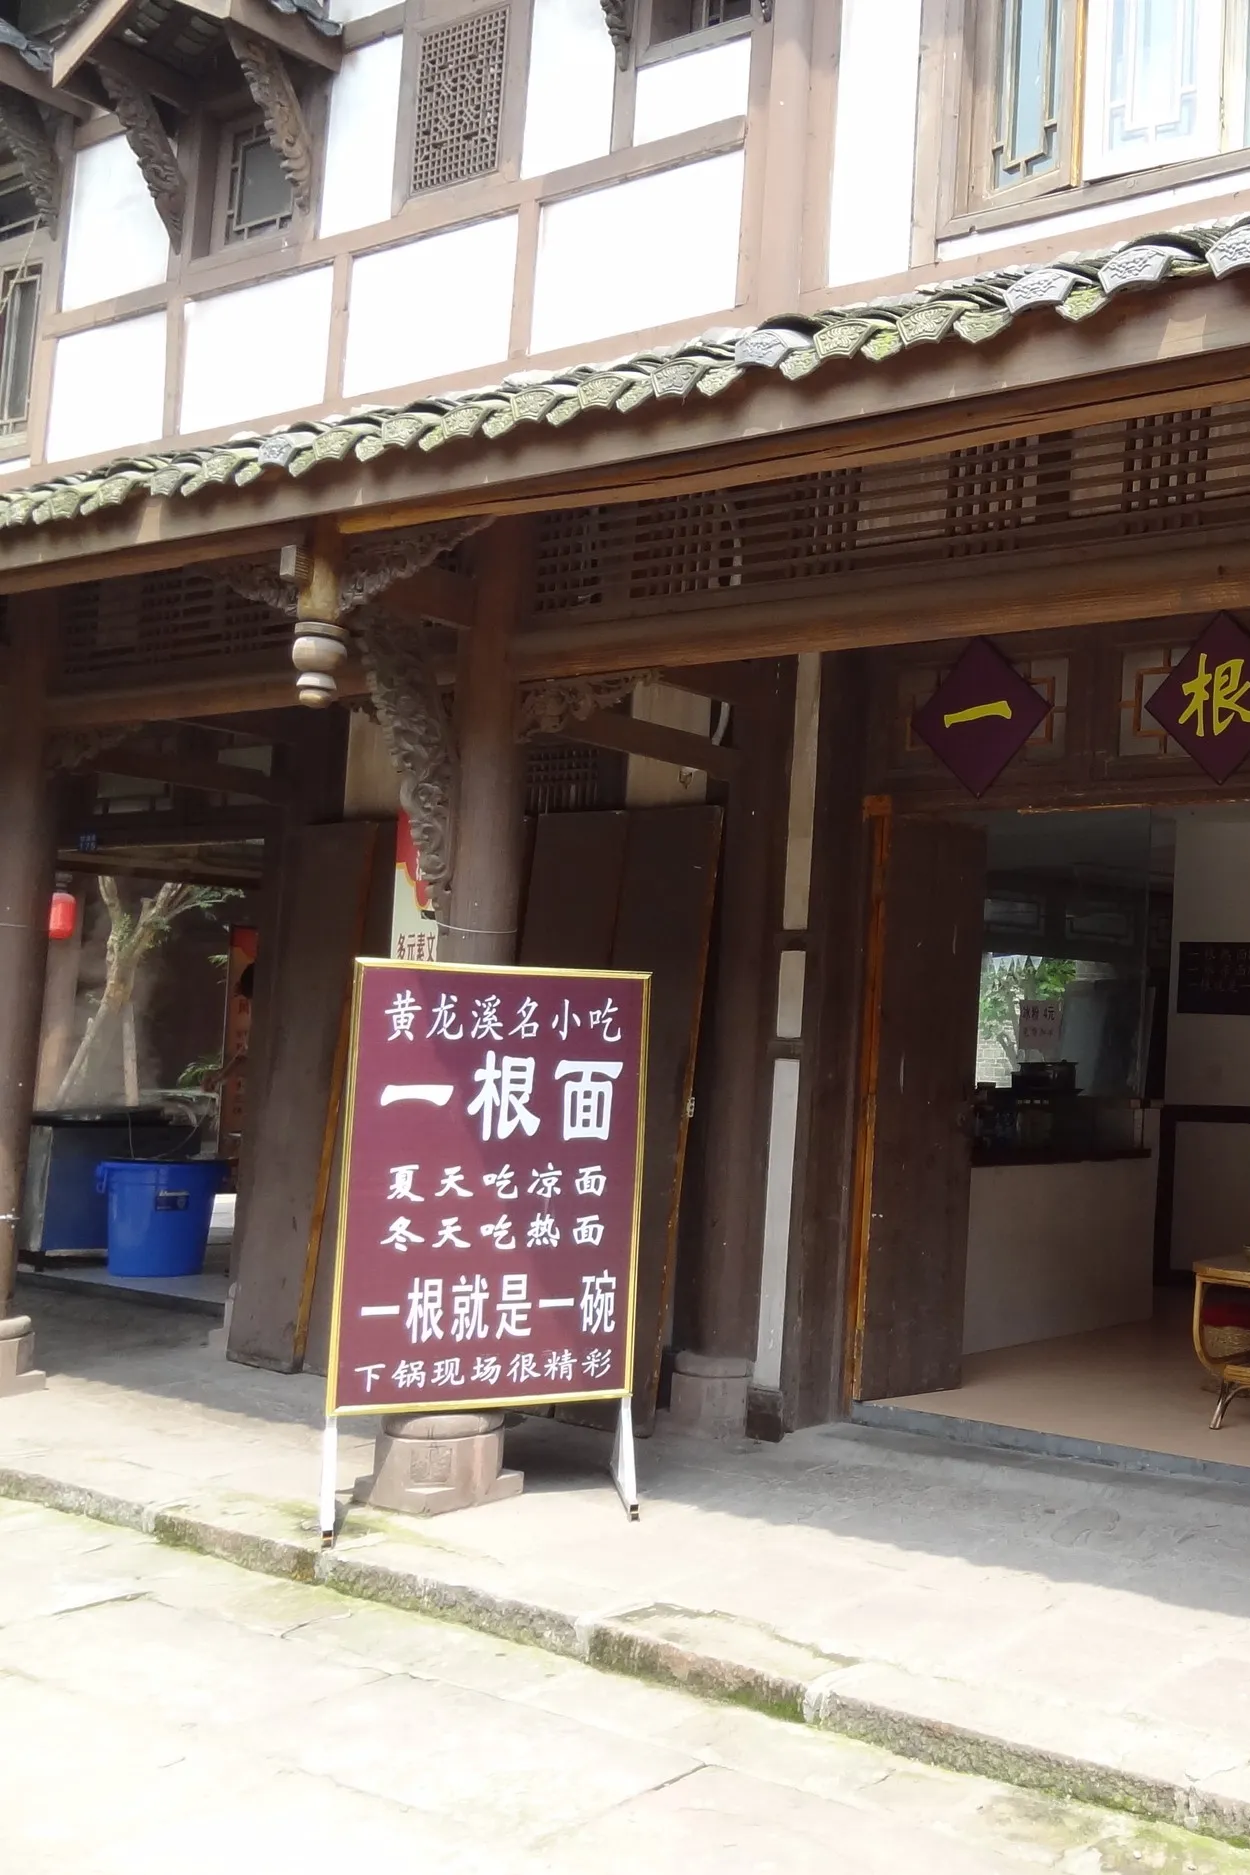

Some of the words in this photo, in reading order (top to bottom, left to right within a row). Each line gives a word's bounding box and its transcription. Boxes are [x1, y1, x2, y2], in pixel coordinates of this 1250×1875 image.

[384, 989, 622, 1043] 黄龙溪名小吃
[380, 1050, 624, 1142] 一根面
[386, 1163, 608, 1202] 夏天吃凉面
[380, 1215, 605, 1252] 冬天吃热面
[360, 1269, 618, 1344] 一根就是一碗
[354, 1348, 613, 1393] 下锅现场很精彩
